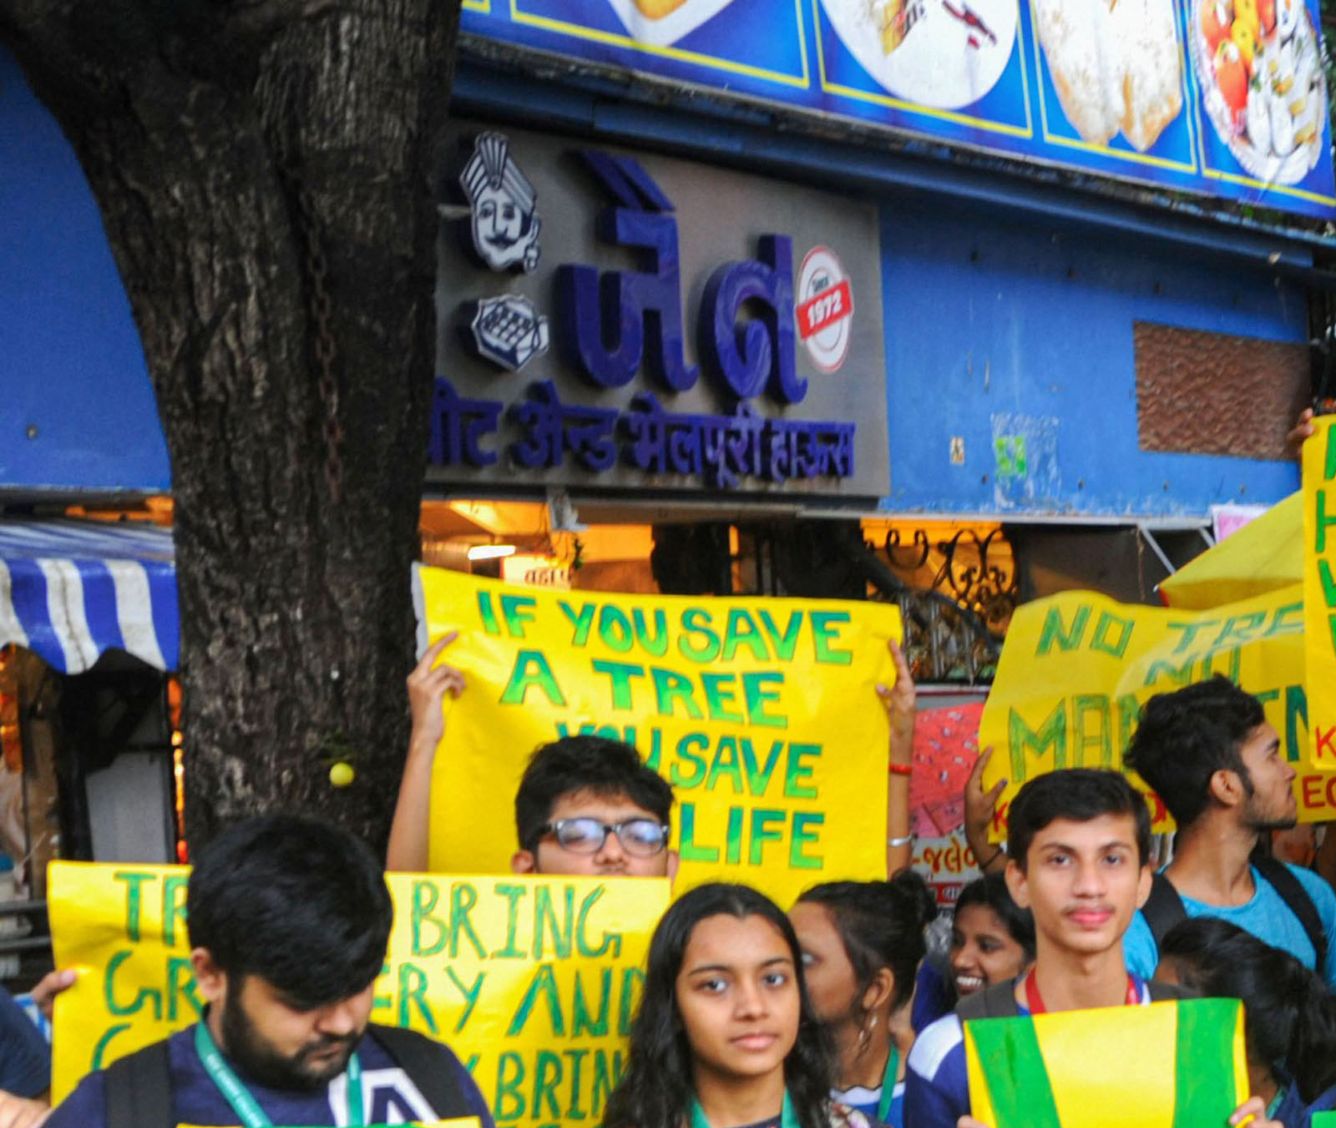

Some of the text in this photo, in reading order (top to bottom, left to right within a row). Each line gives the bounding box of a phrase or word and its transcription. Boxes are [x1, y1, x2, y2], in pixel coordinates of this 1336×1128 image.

[807, 289, 843, 330] 1972
[477, 589, 854, 666] IF YOU SAVE
[1035, 605, 1136, 660] NO
[499, 649, 789, 730] A TREE
[668, 729, 824, 801] SAVE
[676, 800, 827, 871] LIFE
[410, 879, 624, 959] BRING
